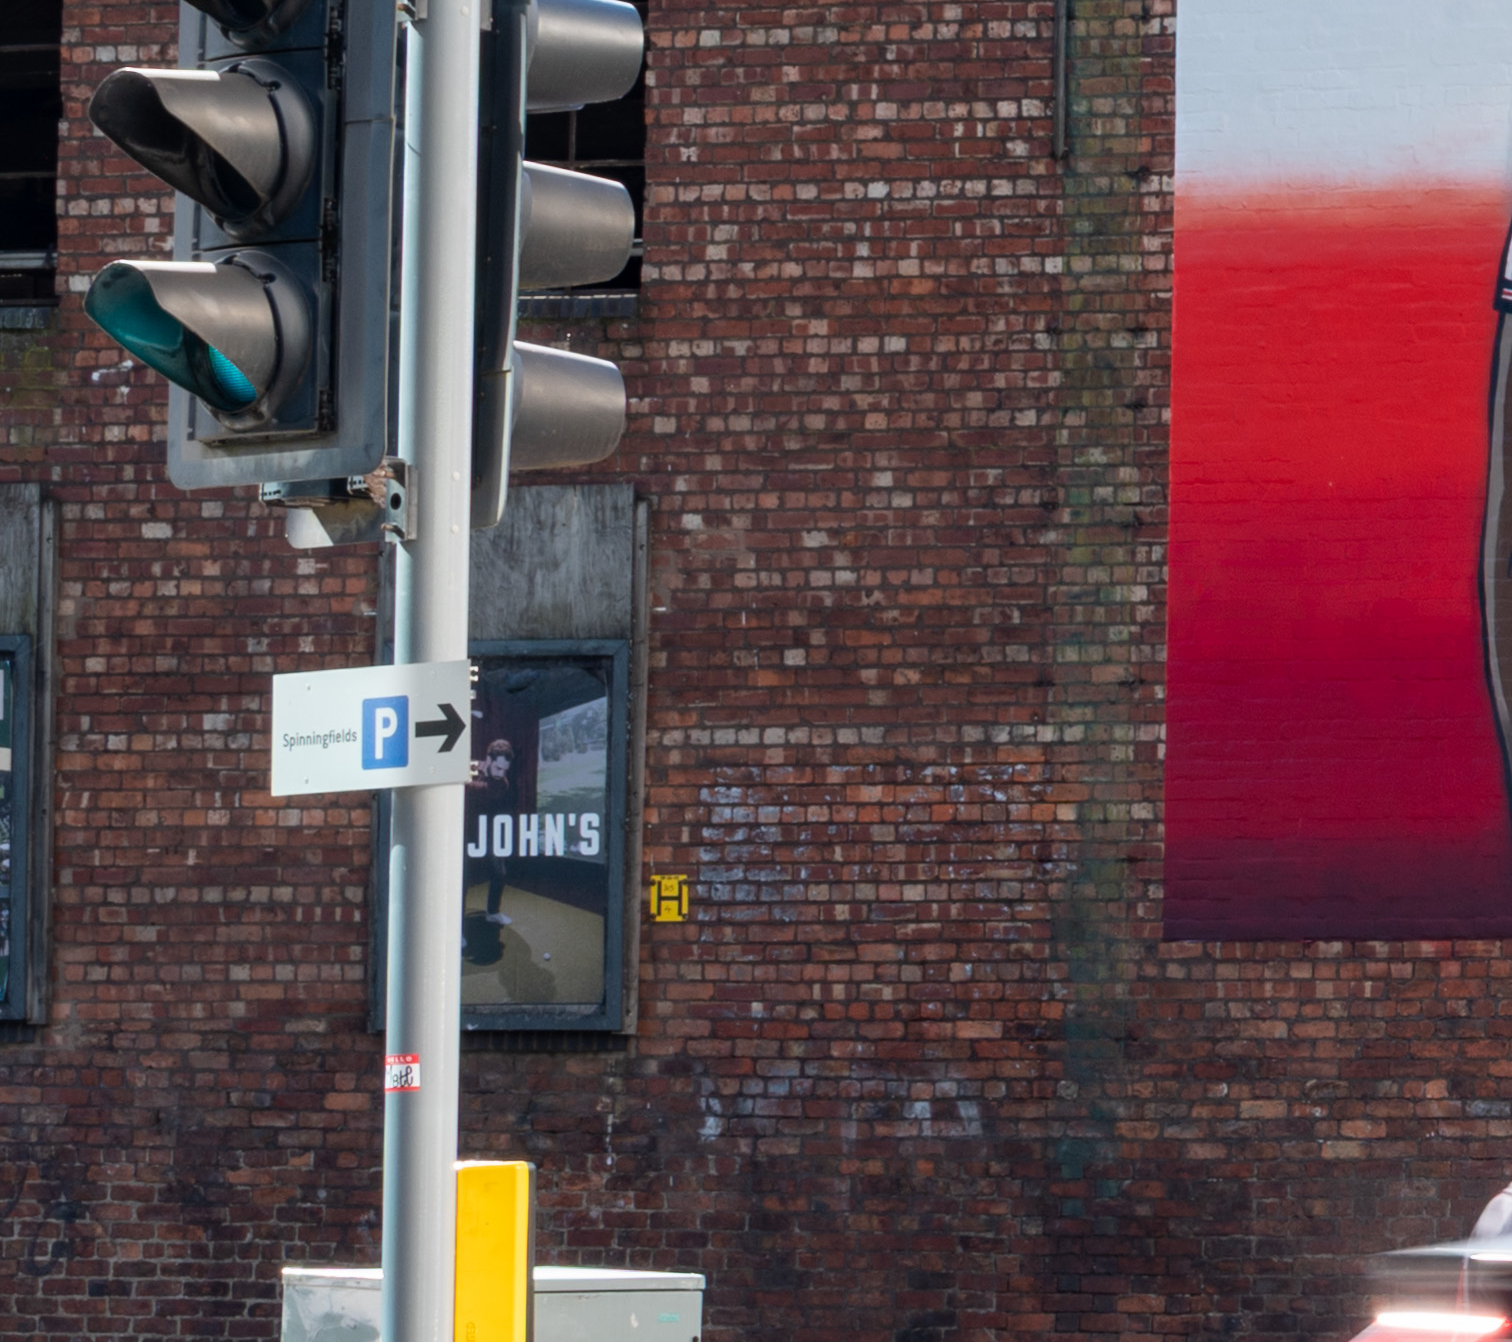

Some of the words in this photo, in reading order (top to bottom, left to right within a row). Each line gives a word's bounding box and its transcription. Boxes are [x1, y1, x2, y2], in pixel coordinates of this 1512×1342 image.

[283, 728, 357, 751] Spinningfields
[375, 707, 398, 759] P
[467, 812, 600, 858] JOHN'S
